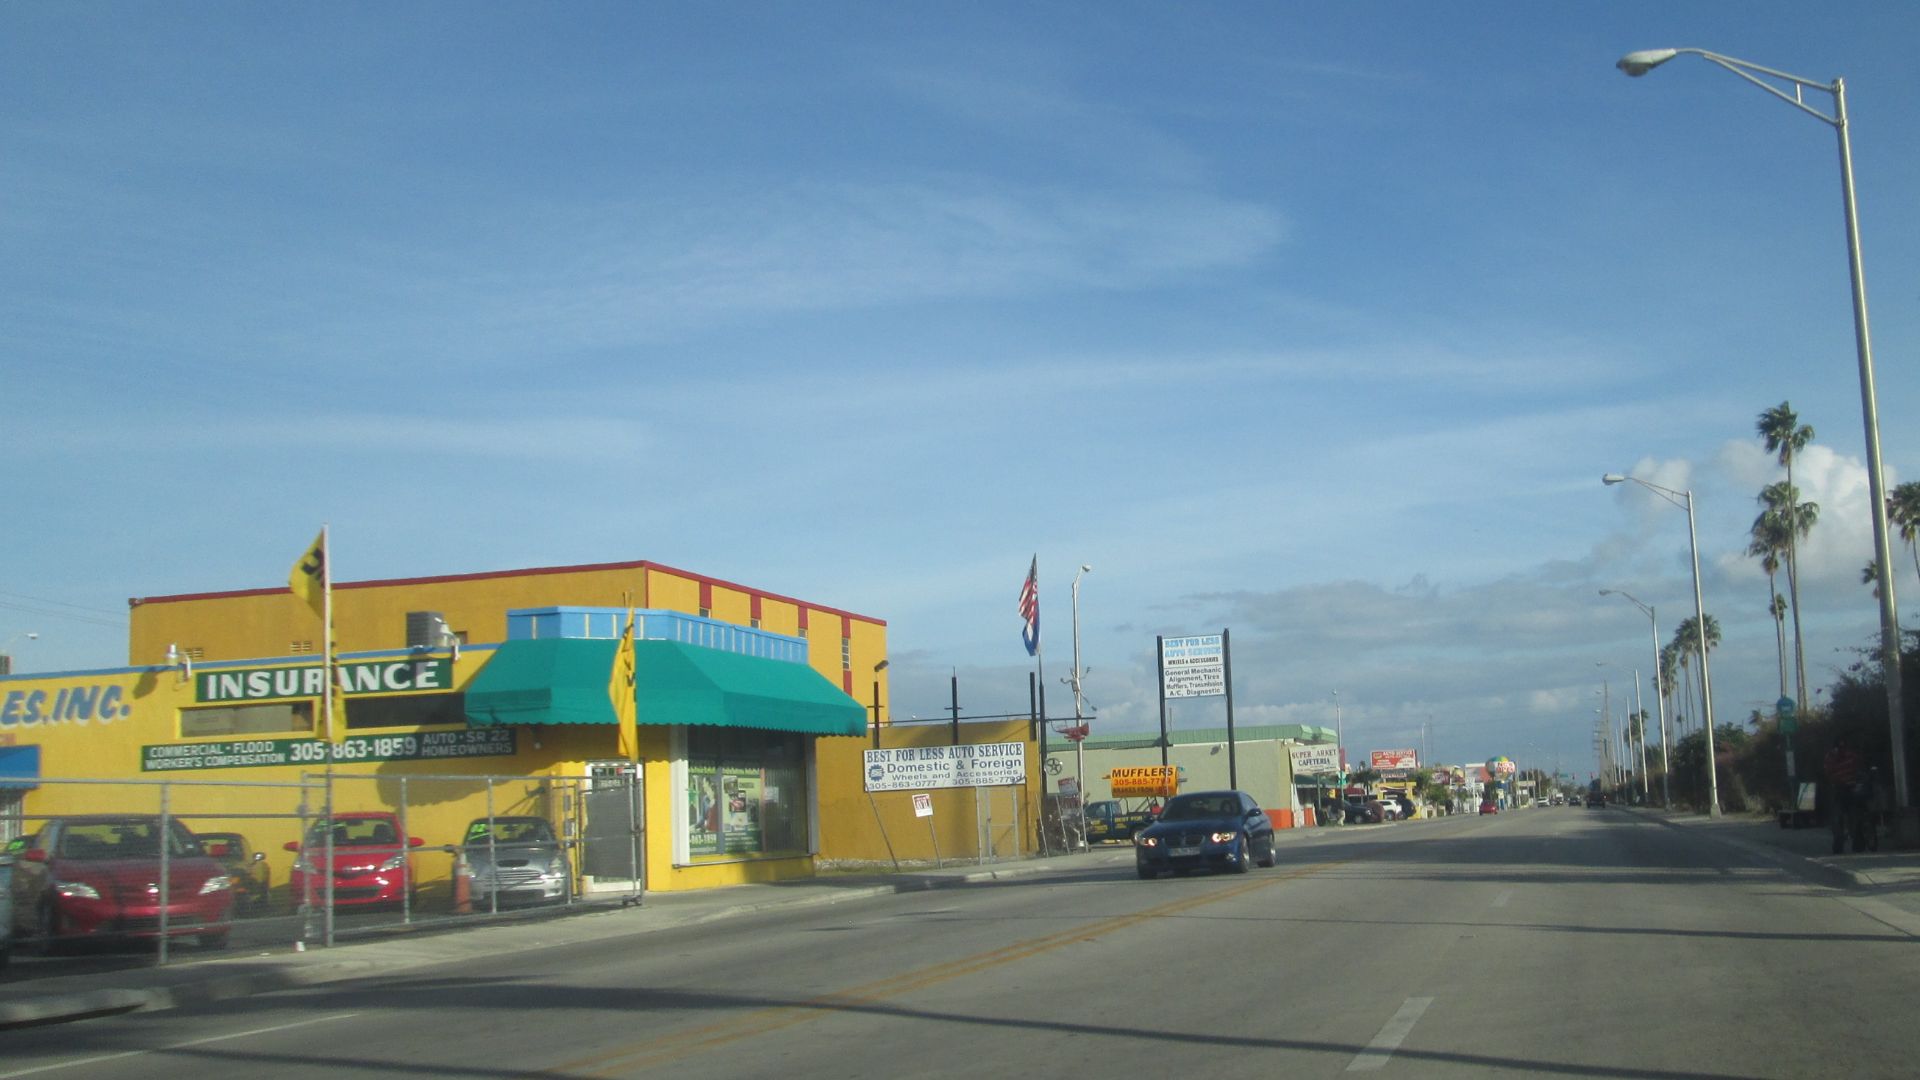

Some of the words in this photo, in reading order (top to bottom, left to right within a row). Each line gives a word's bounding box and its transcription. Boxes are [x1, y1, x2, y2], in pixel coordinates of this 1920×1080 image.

[1187, 689, 1220, 697] Diagnostic
[422, 732, 456, 745] AUTO
[150, 743, 224, 758] COMMERCIAL
[233, 741, 274, 753] FLOOD
[290, 736, 417, 761] 305-863-1859
[422, 742, 512, 757] HOMEOWNERS
[867, 750, 891, 762] BEST
[896, 749, 915, 761] FOR
[920, 747, 945, 760] LESS
[949, 746, 975, 759] AUTO
[978, 743, 1022, 757] SERVICE
[1291, 751, 1312, 759] SUPER
[145, 756, 203, 770] WORKER'S
[205, 753, 286, 767] COMPENSATION
[887, 761, 950, 773] Domestic
[956, 759, 965, 770] &
[971, 757, 1022, 770] Foreign
[892, 773, 928, 781] Wheels
[956, 769, 1018, 778] Accessories
[1112, 767, 1174, 777] MUFFLERS
[868, 780, 937, 790] 305-863-0777
